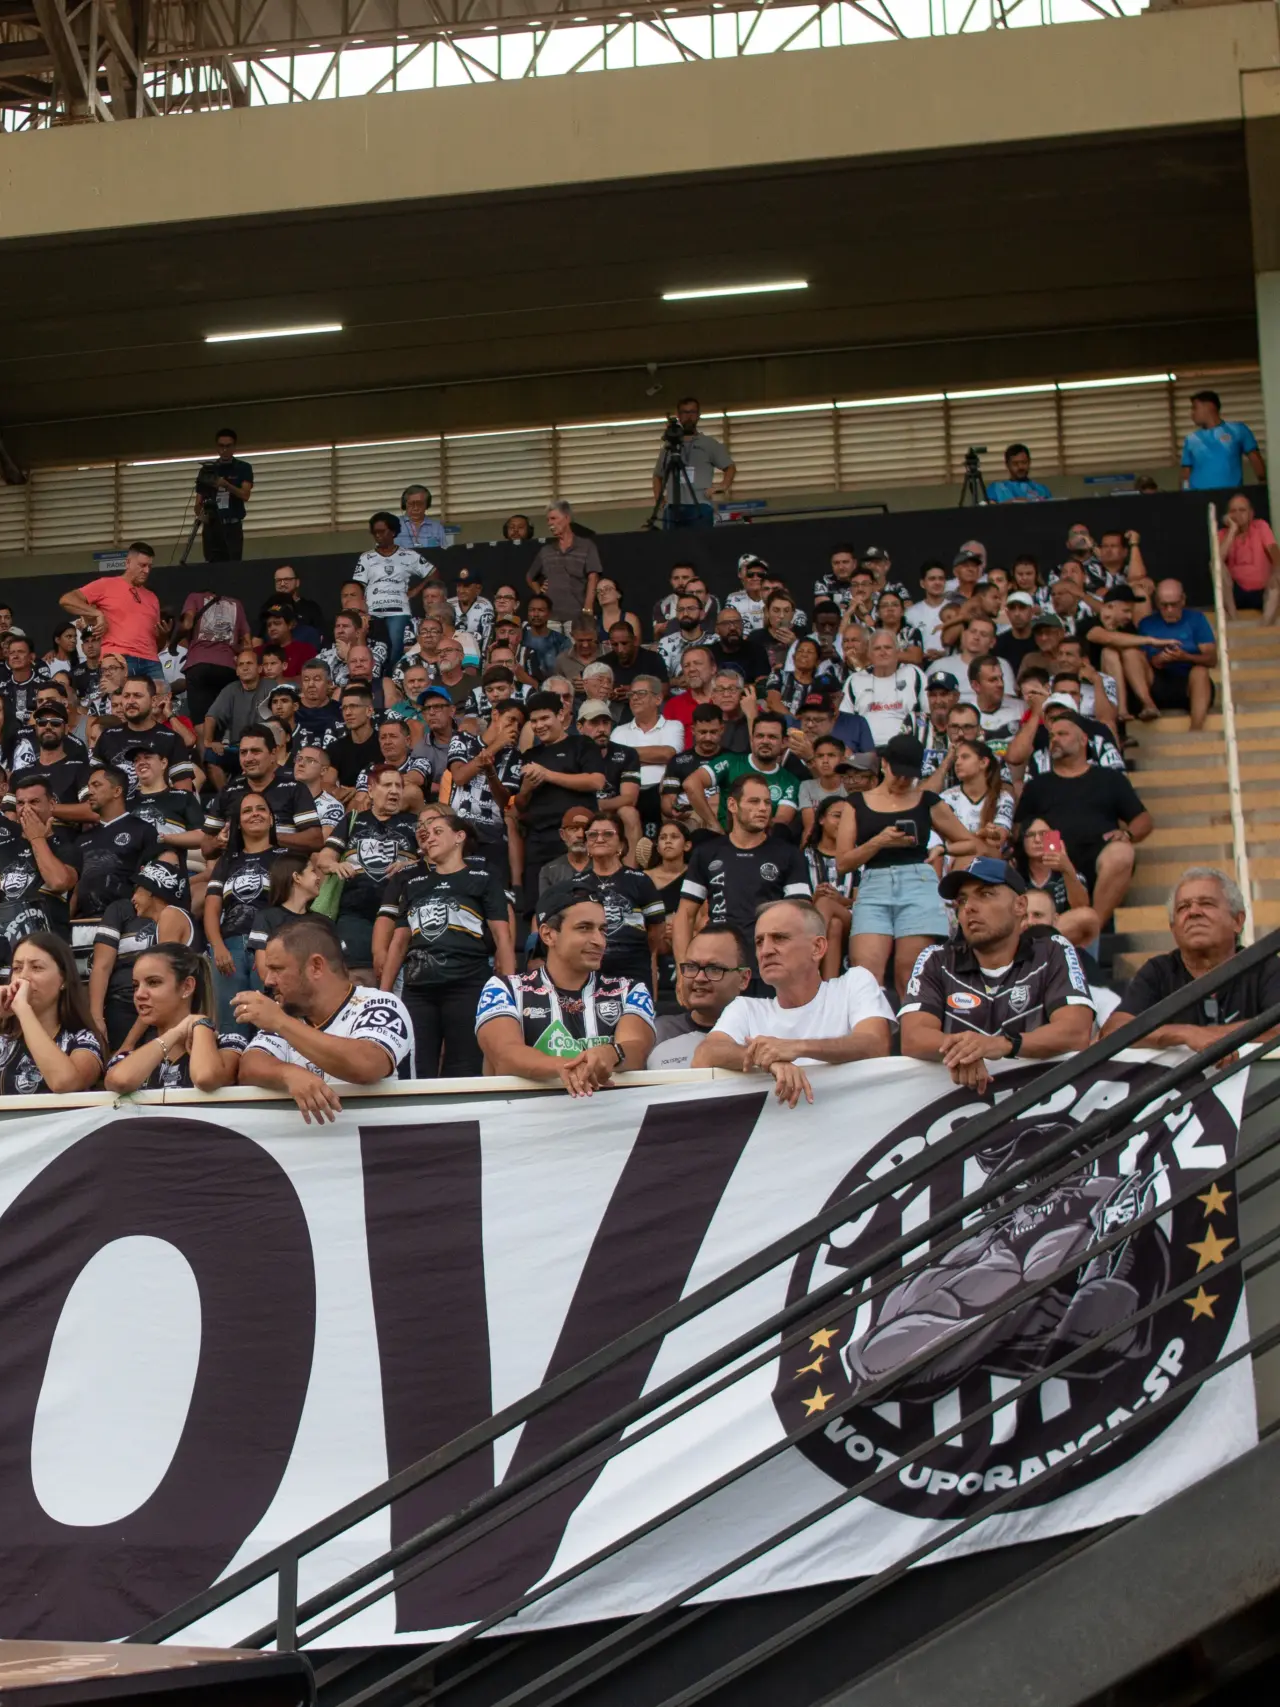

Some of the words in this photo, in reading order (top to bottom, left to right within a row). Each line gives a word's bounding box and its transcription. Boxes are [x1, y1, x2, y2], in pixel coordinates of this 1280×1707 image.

[363, 997, 398, 1009] GRUPO
[352, 1009, 403, 1036] HSA
[554, 1035, 615, 1052] CONVER
